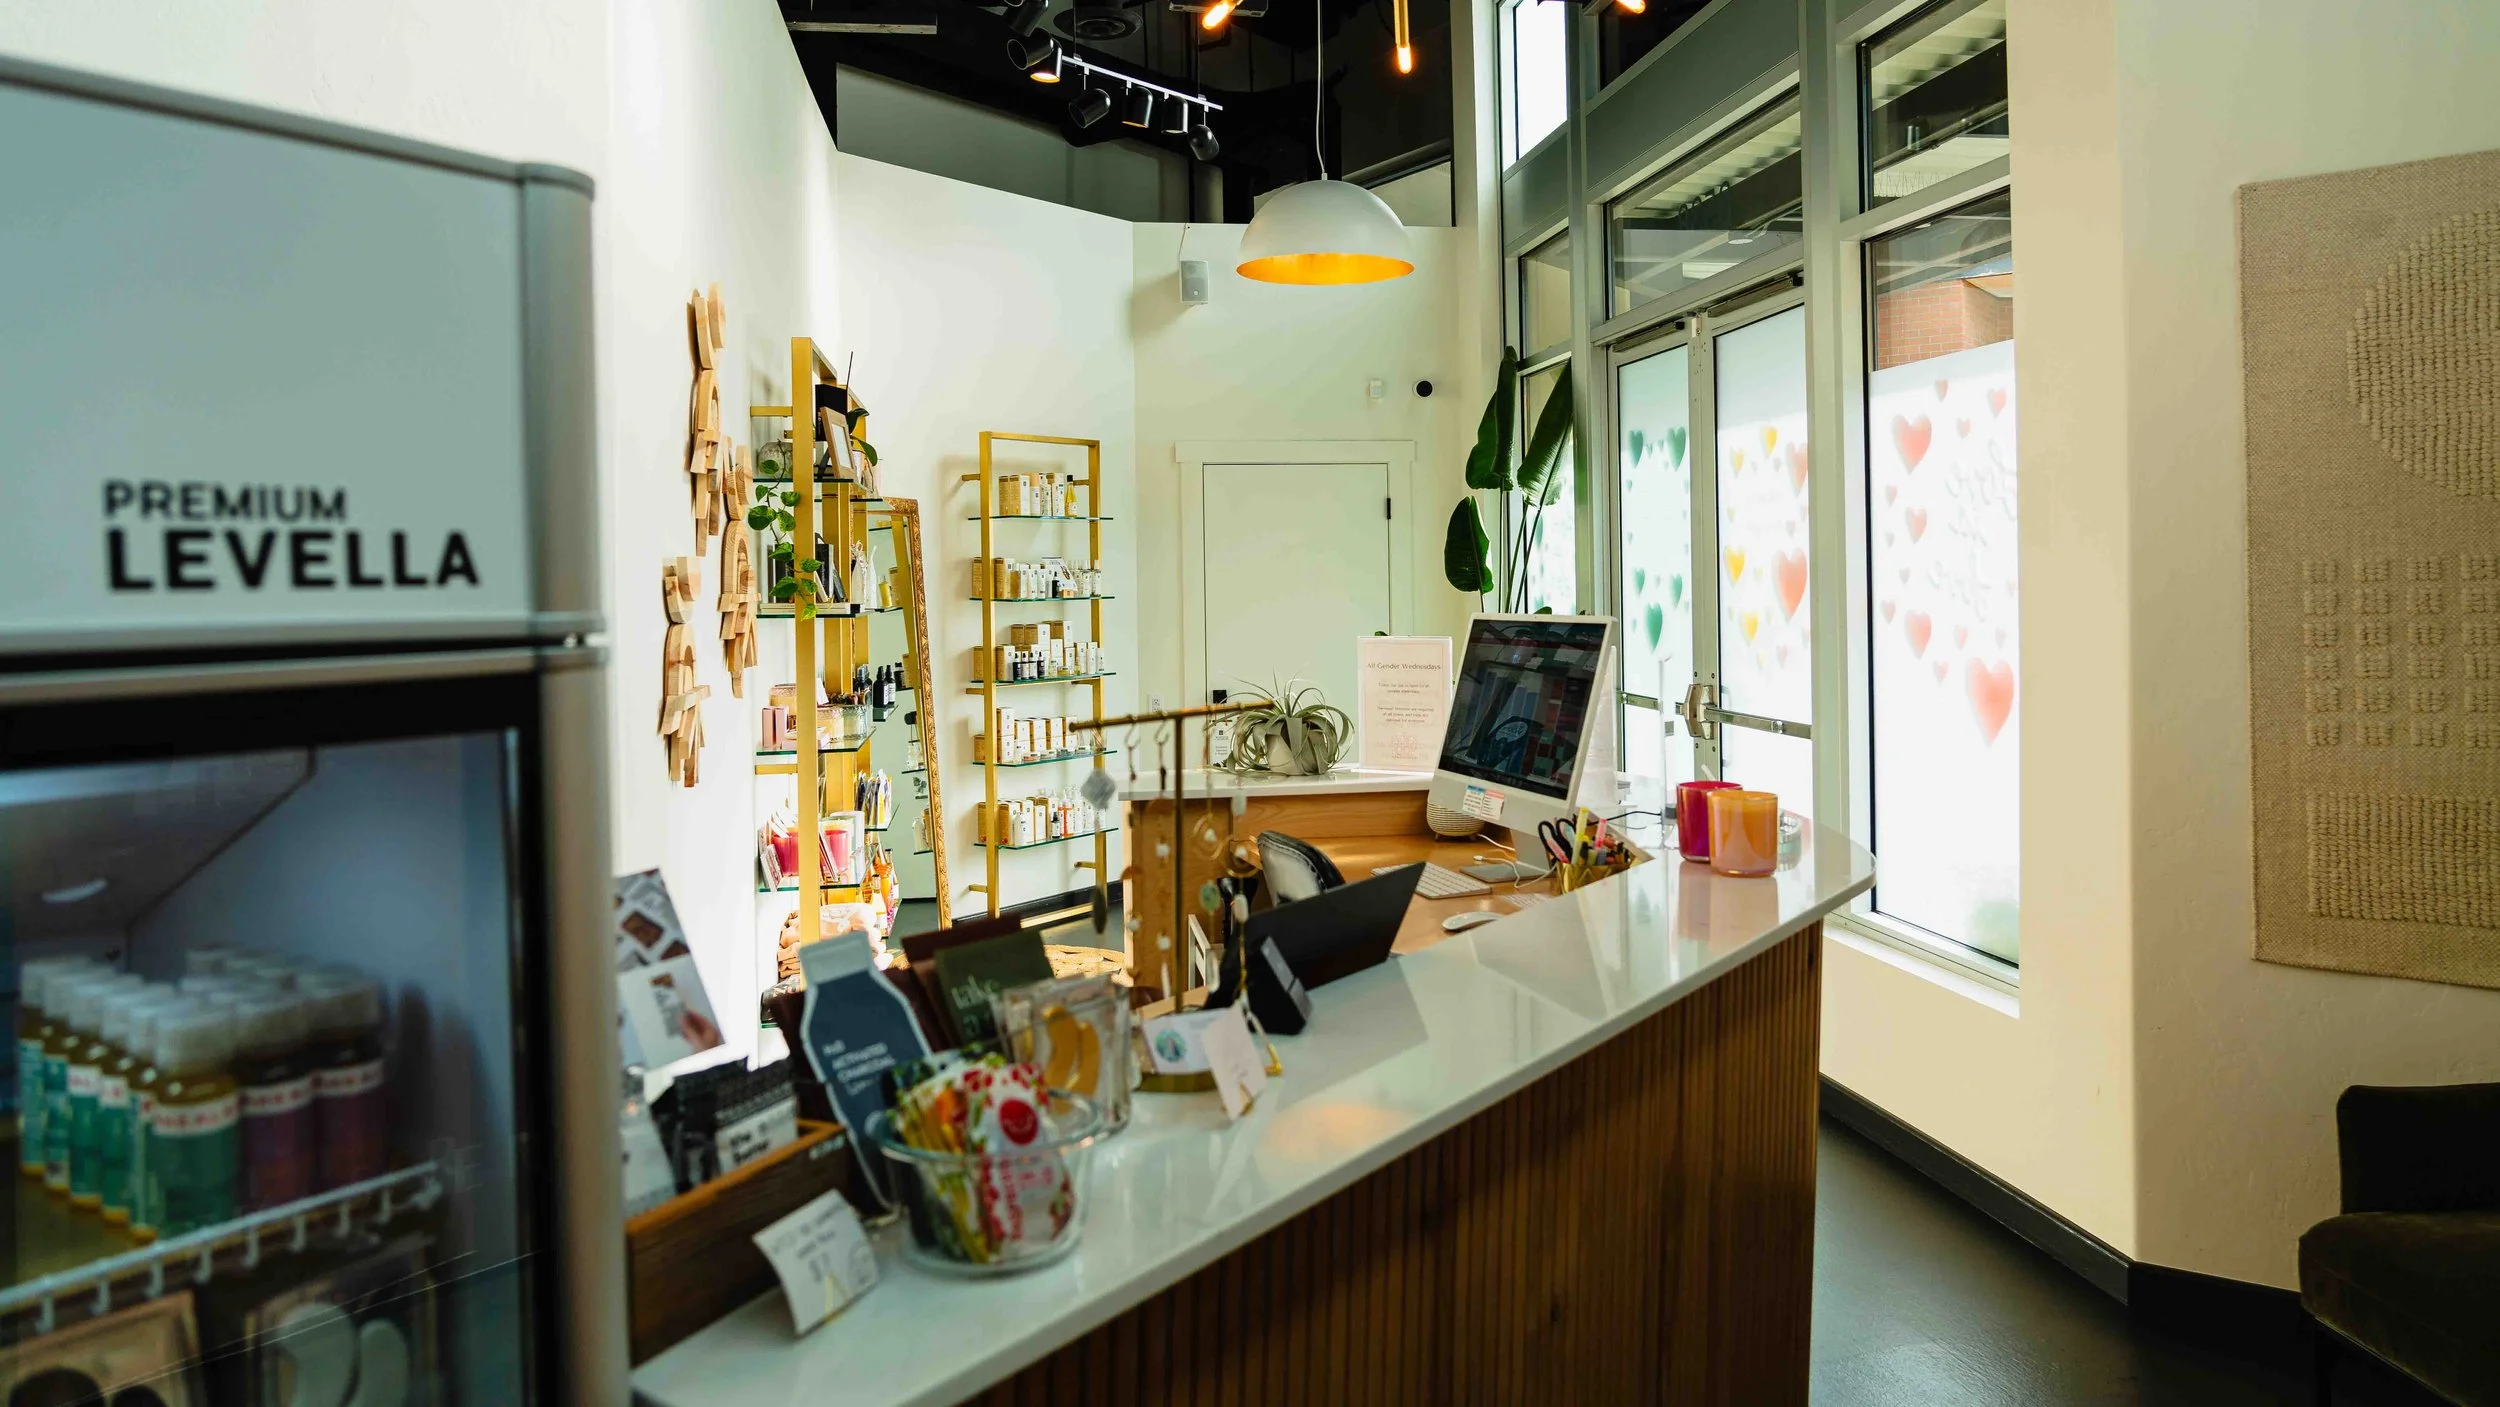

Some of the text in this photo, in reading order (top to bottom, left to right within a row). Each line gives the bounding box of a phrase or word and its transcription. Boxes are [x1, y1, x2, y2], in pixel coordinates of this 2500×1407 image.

[103, 480, 347, 522] PREMIUM
[105, 528, 481, 592] LEVELLA
[1402, 663, 1441, 672] Wednesdays
